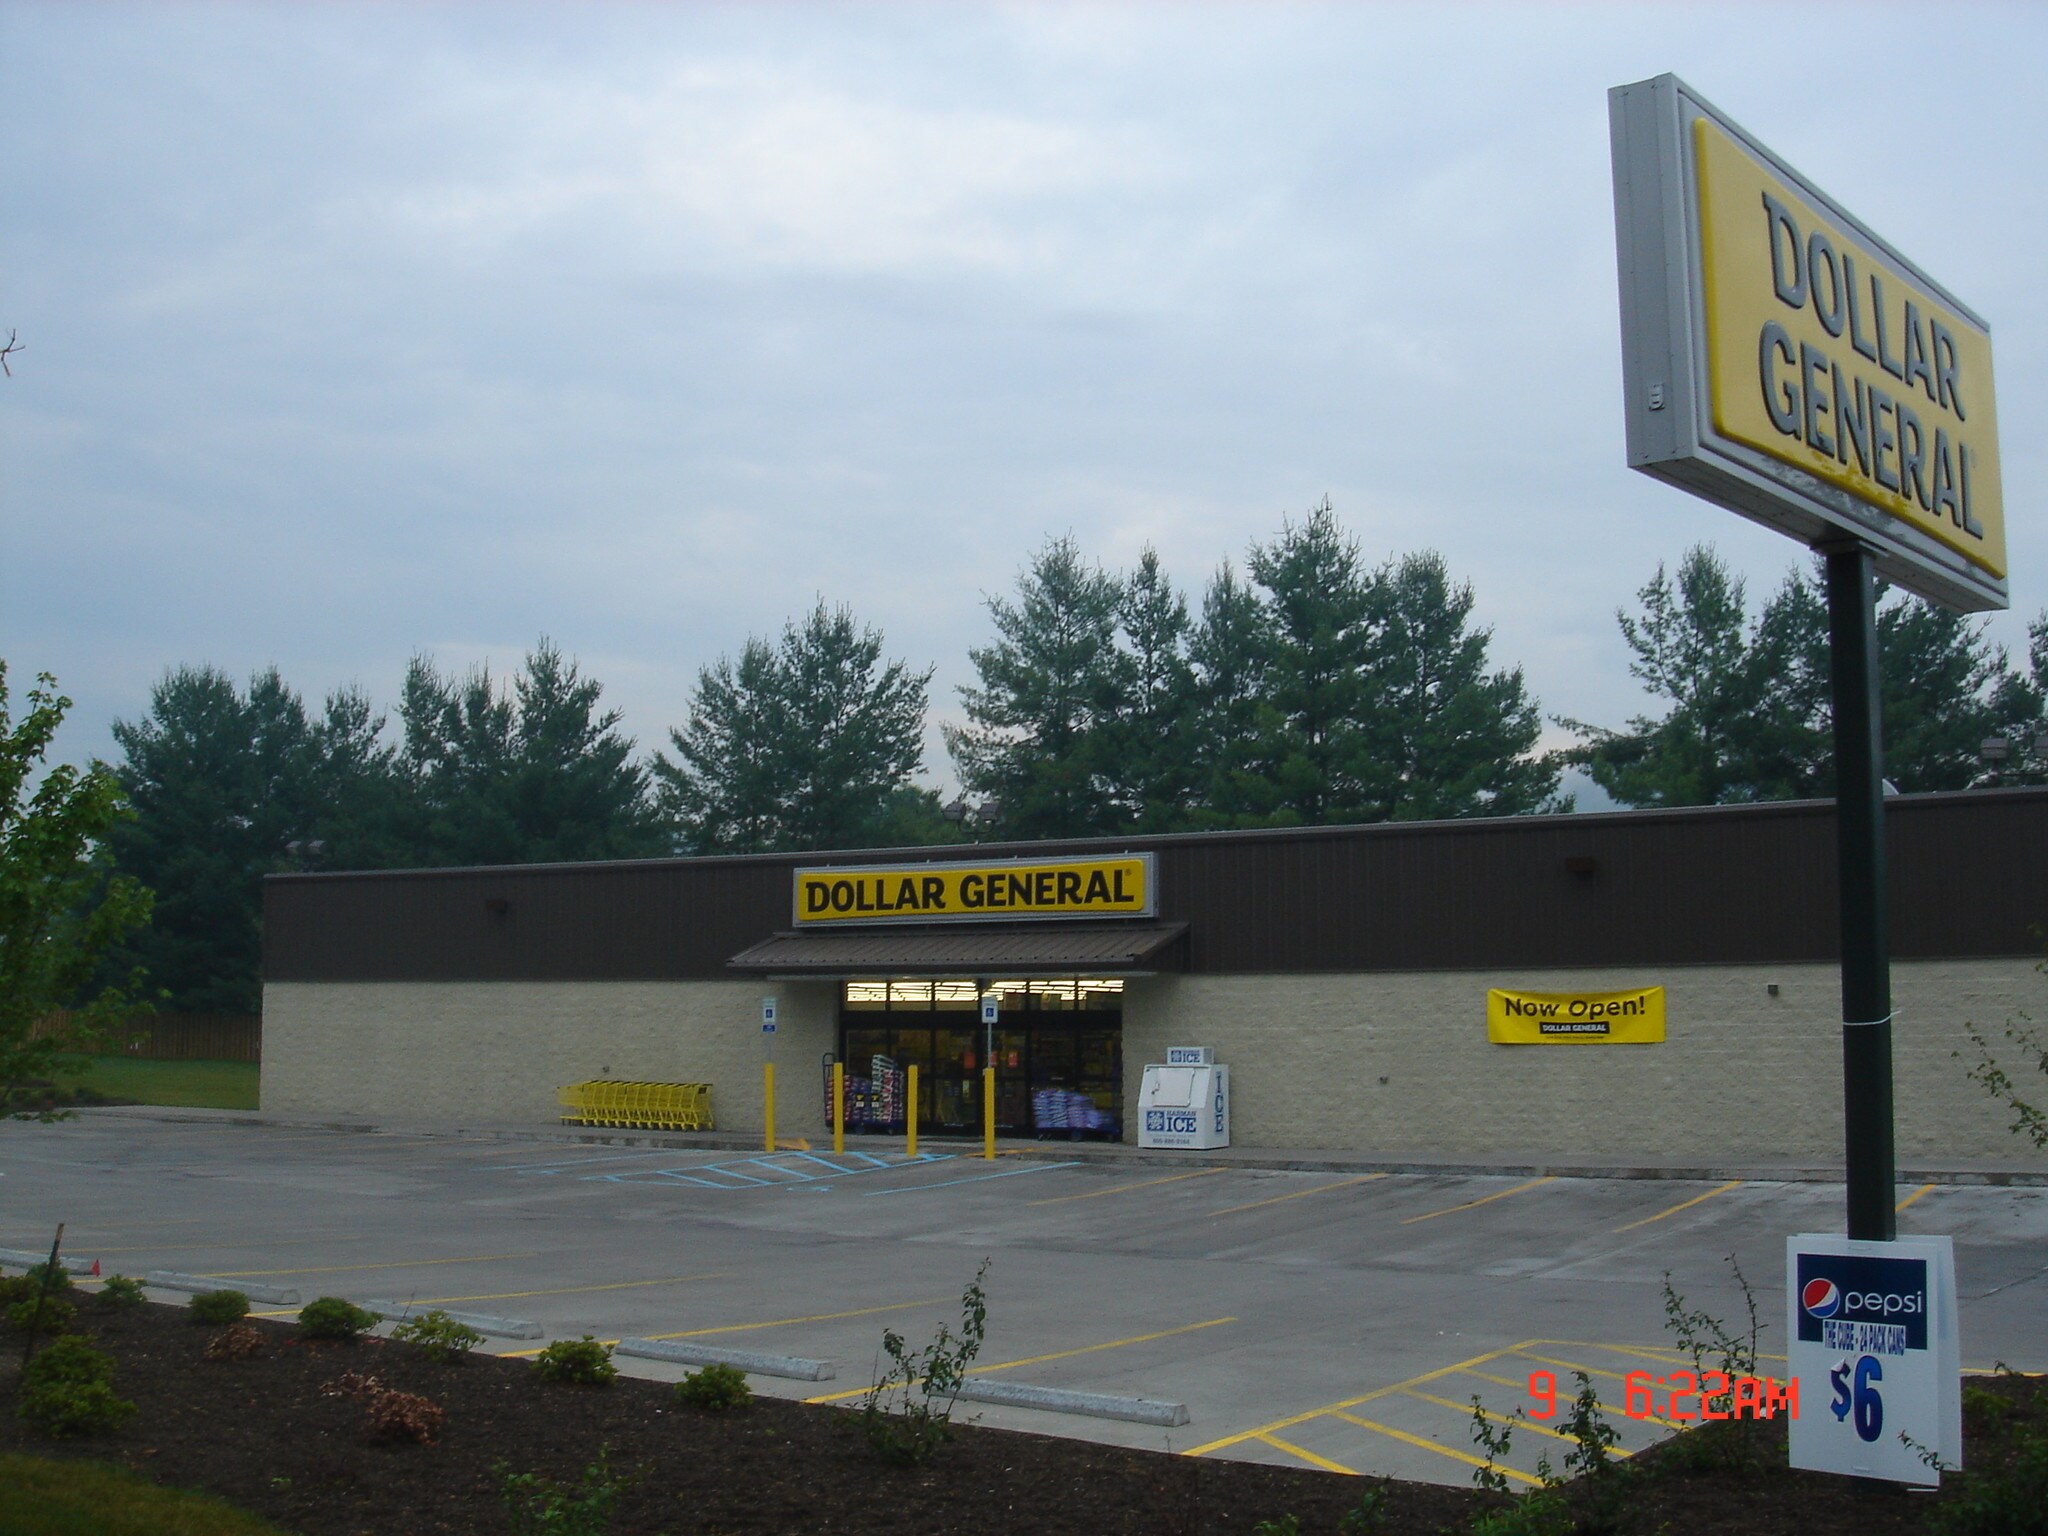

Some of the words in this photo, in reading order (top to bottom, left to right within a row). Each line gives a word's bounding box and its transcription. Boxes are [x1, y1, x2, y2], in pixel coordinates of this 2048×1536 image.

[1761, 190, 1965, 421] DOLLAR
[1759, 320, 1982, 540] GENERAL
[806, 877, 946, 913] DOLLAR
[959, 869, 1135, 908] GENERAL
[1505, 997, 1560, 1016] Now
[1568, 996, 1646, 1020] Open!
[1542, 1024, 1571, 1032] DOLLAR
[1572, 1023, 1606, 1032] GENERAL
[1183, 1053, 1200, 1063] ICE
[1215, 1075, 1224, 1133] ICE
[1166, 1117, 1197, 1133] ICE
[1844, 1291, 1922, 1316] pepsi
[1824, 1321, 1836, 1349] THE
[1830, 1355, 1883, 1442] $6
